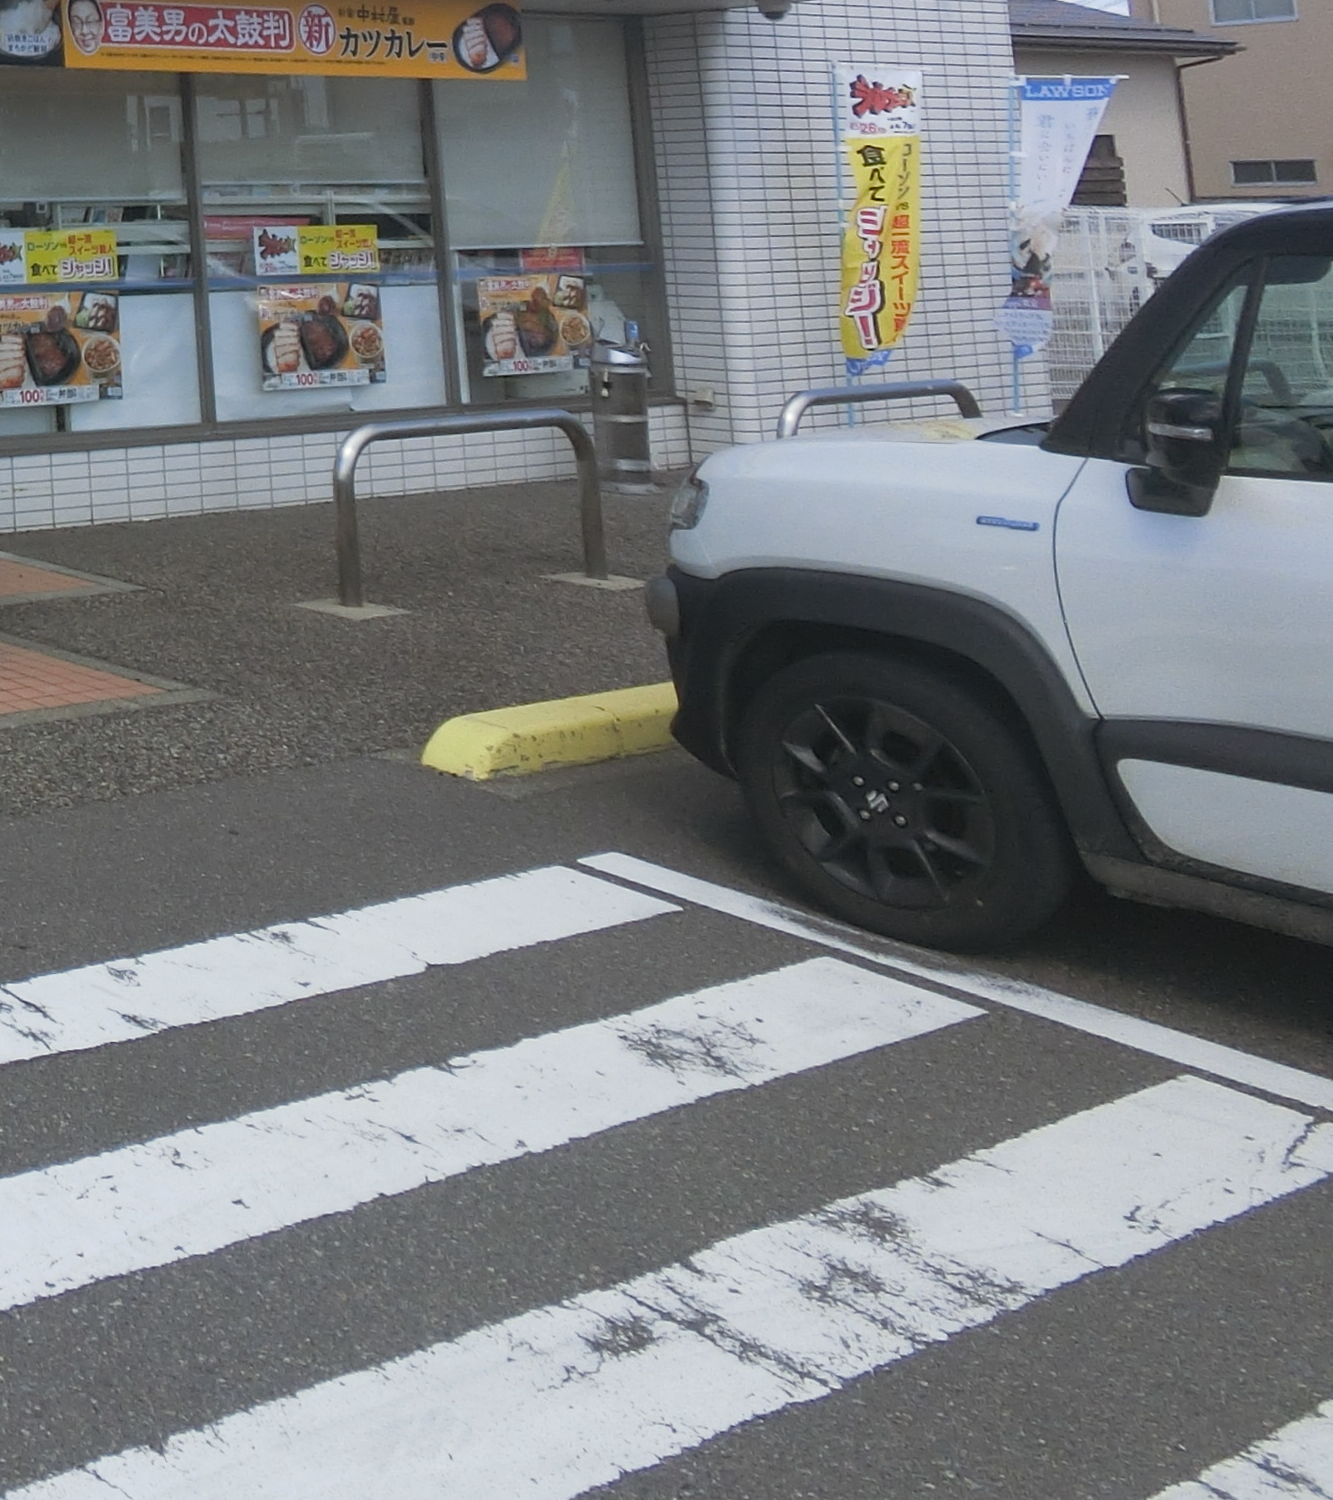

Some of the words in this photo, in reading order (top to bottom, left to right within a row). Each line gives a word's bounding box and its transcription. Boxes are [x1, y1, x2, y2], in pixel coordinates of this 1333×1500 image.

[106, 4, 289, 47] 富美男の太鼓判
[302, 9, 333, 51] 新
[339, 27, 449, 59] カツカレー
[1025, 83, 1109, 99] LAWSON
[856, 145, 887, 202] 食べて
[31, 263, 58, 277] 食べて
[304, 255, 327, 268] 食べて
